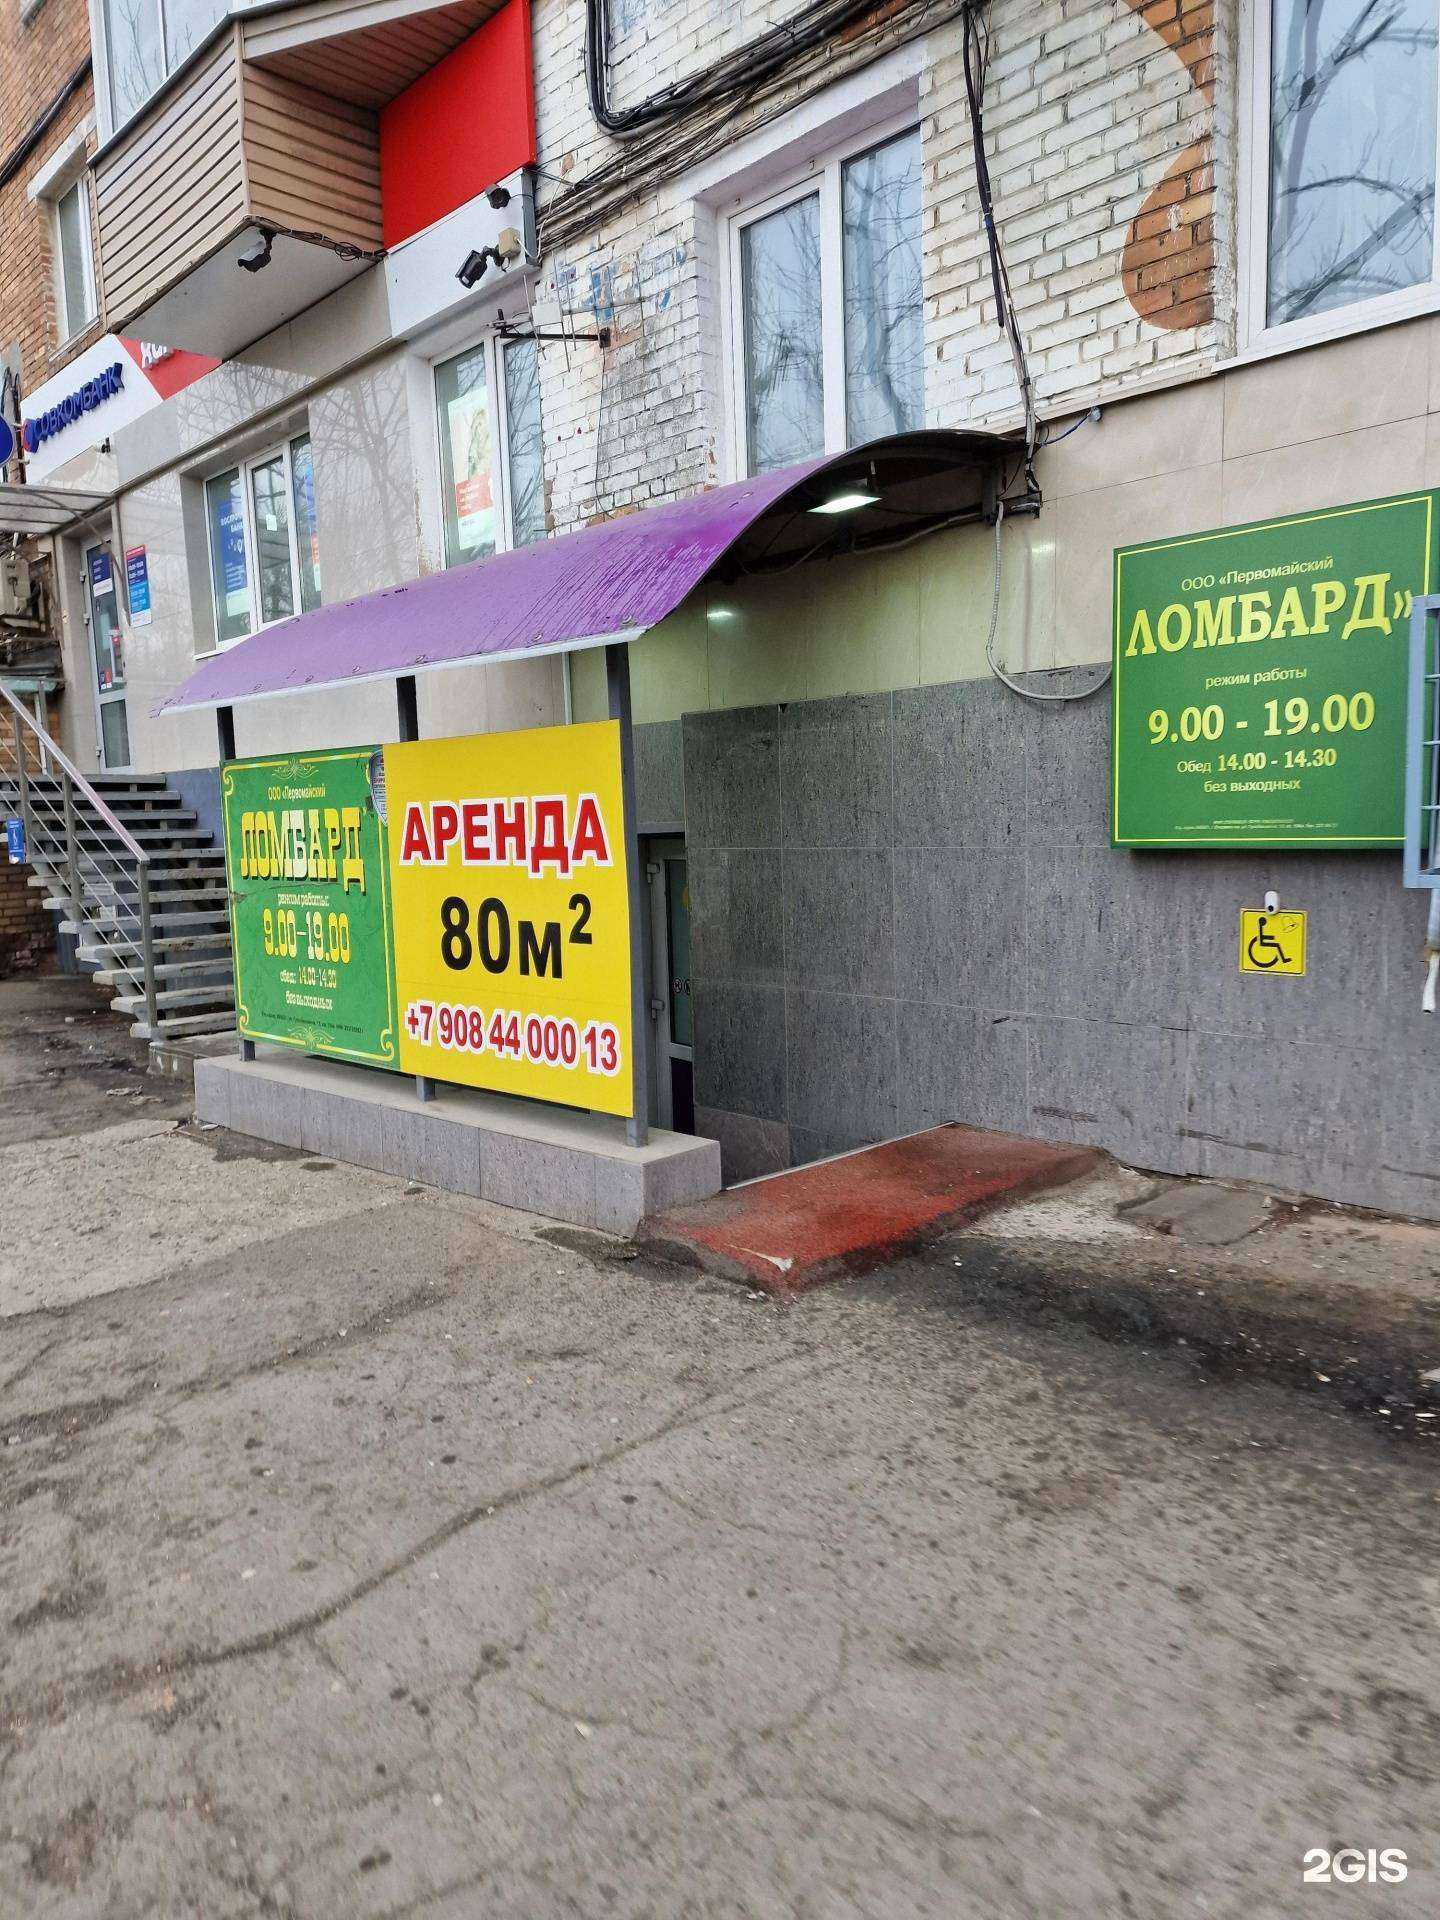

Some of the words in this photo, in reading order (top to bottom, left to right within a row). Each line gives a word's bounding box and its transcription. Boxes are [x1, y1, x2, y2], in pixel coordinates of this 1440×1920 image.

[1181, 575, 1215, 592] ООО
[1218, 556, 1334, 586] «Первомайский
[1125, 572, 1413, 657] ЛОМБАРД»
[1205, 673, 1250, 690] режим
[1253, 667, 1307, 686] работы
[1148, 705, 1225, 745] 9.00
[1264, 692, 1375, 737] 19.00
[1176, 760, 1212, 775] Обед
[1217, 753, 1267, 773] 14.00
[1284, 748, 1338, 769] 14.30
[267, 786, 281, 800] ООО
[1204, 780, 1228, 794] без
[1230, 778, 1302, 794] выходных
[240, 807, 366, 896] ЛОМБАРД
[402, 797, 610, 875] АРЕНДА
[406, 1004, 434, 1042] +7
[439, 1006, 484, 1050] 908
[489, 1013, 521, 1056] 44
[526, 1018, 577, 1066] 000
[584, 1025, 618, 1071] 13
